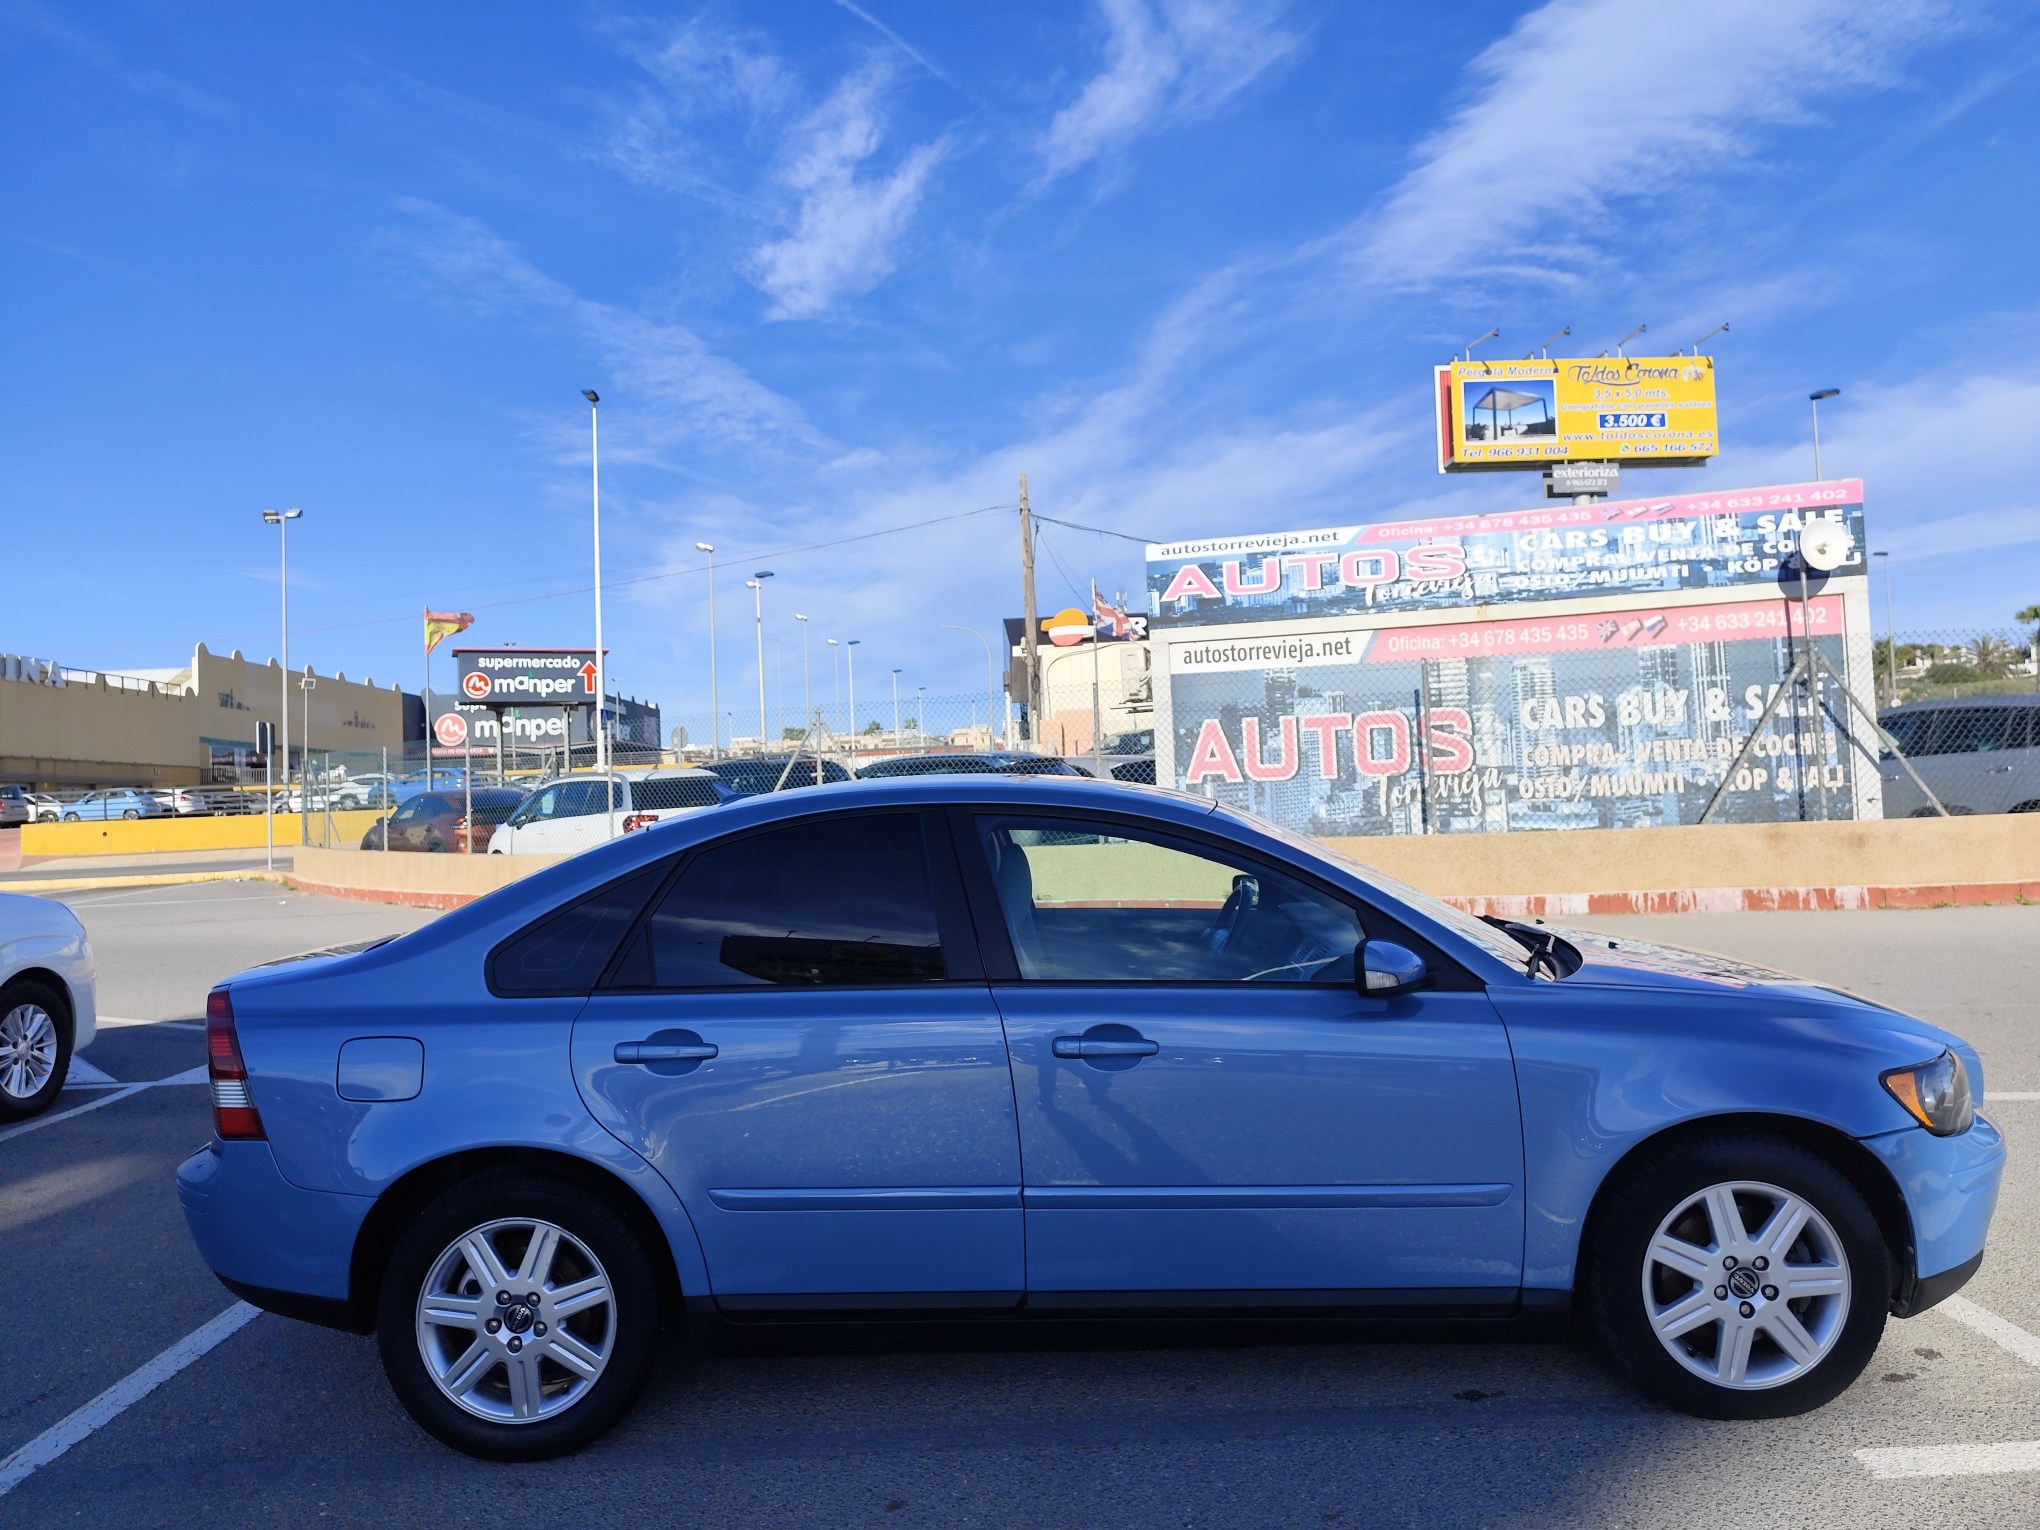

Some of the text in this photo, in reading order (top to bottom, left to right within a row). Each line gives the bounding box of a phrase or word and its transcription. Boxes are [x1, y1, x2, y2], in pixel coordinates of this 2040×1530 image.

[1458, 364, 1559, 379] Pérgla Modern
[1568, 363, 1678, 385] Toldos Corona
[1604, 414, 1662, 428] 3.500 €
[1488, 447, 1513, 457] 966
[1516, 447, 1540, 456] 931
[1544, 445, 1568, 455] 004
[1634, 442, 1713, 453] 665 166 572
[1553, 466, 1619, 479] exterioriza
[1686, 488, 1847, 511] +34 633 241 402
[1378, 510, 1592, 538] Oficina: +34 678 435 435
[1161, 530, 1341, 557] autostorrevieja.net
[1520, 528, 1608, 552] CARS
[1623, 520, 1698, 543] BUY
[1724, 542, 1754, 557] DE
[1160, 544, 1468, 603] AUTOS
[1727, 556, 1779, 574] KÖP
[1677, 607, 1827, 633] +34 633 241 402
[1388, 623, 1589, 652] Oficina: +34 678 435 435
[1183, 637, 1352, 665] autostorrevieja.net
[478, 655, 581, 671] supermercado
[494, 674, 576, 698] manper
[1521, 692, 1606, 731] CARS
[1618, 688, 1689, 727] BUY
[1705, 686, 1733, 722] &
[1186, 706, 1475, 785] AUTOS
[1776, 766, 1795, 790] &
[1733, 1274, 1754, 1293] VOLVO
